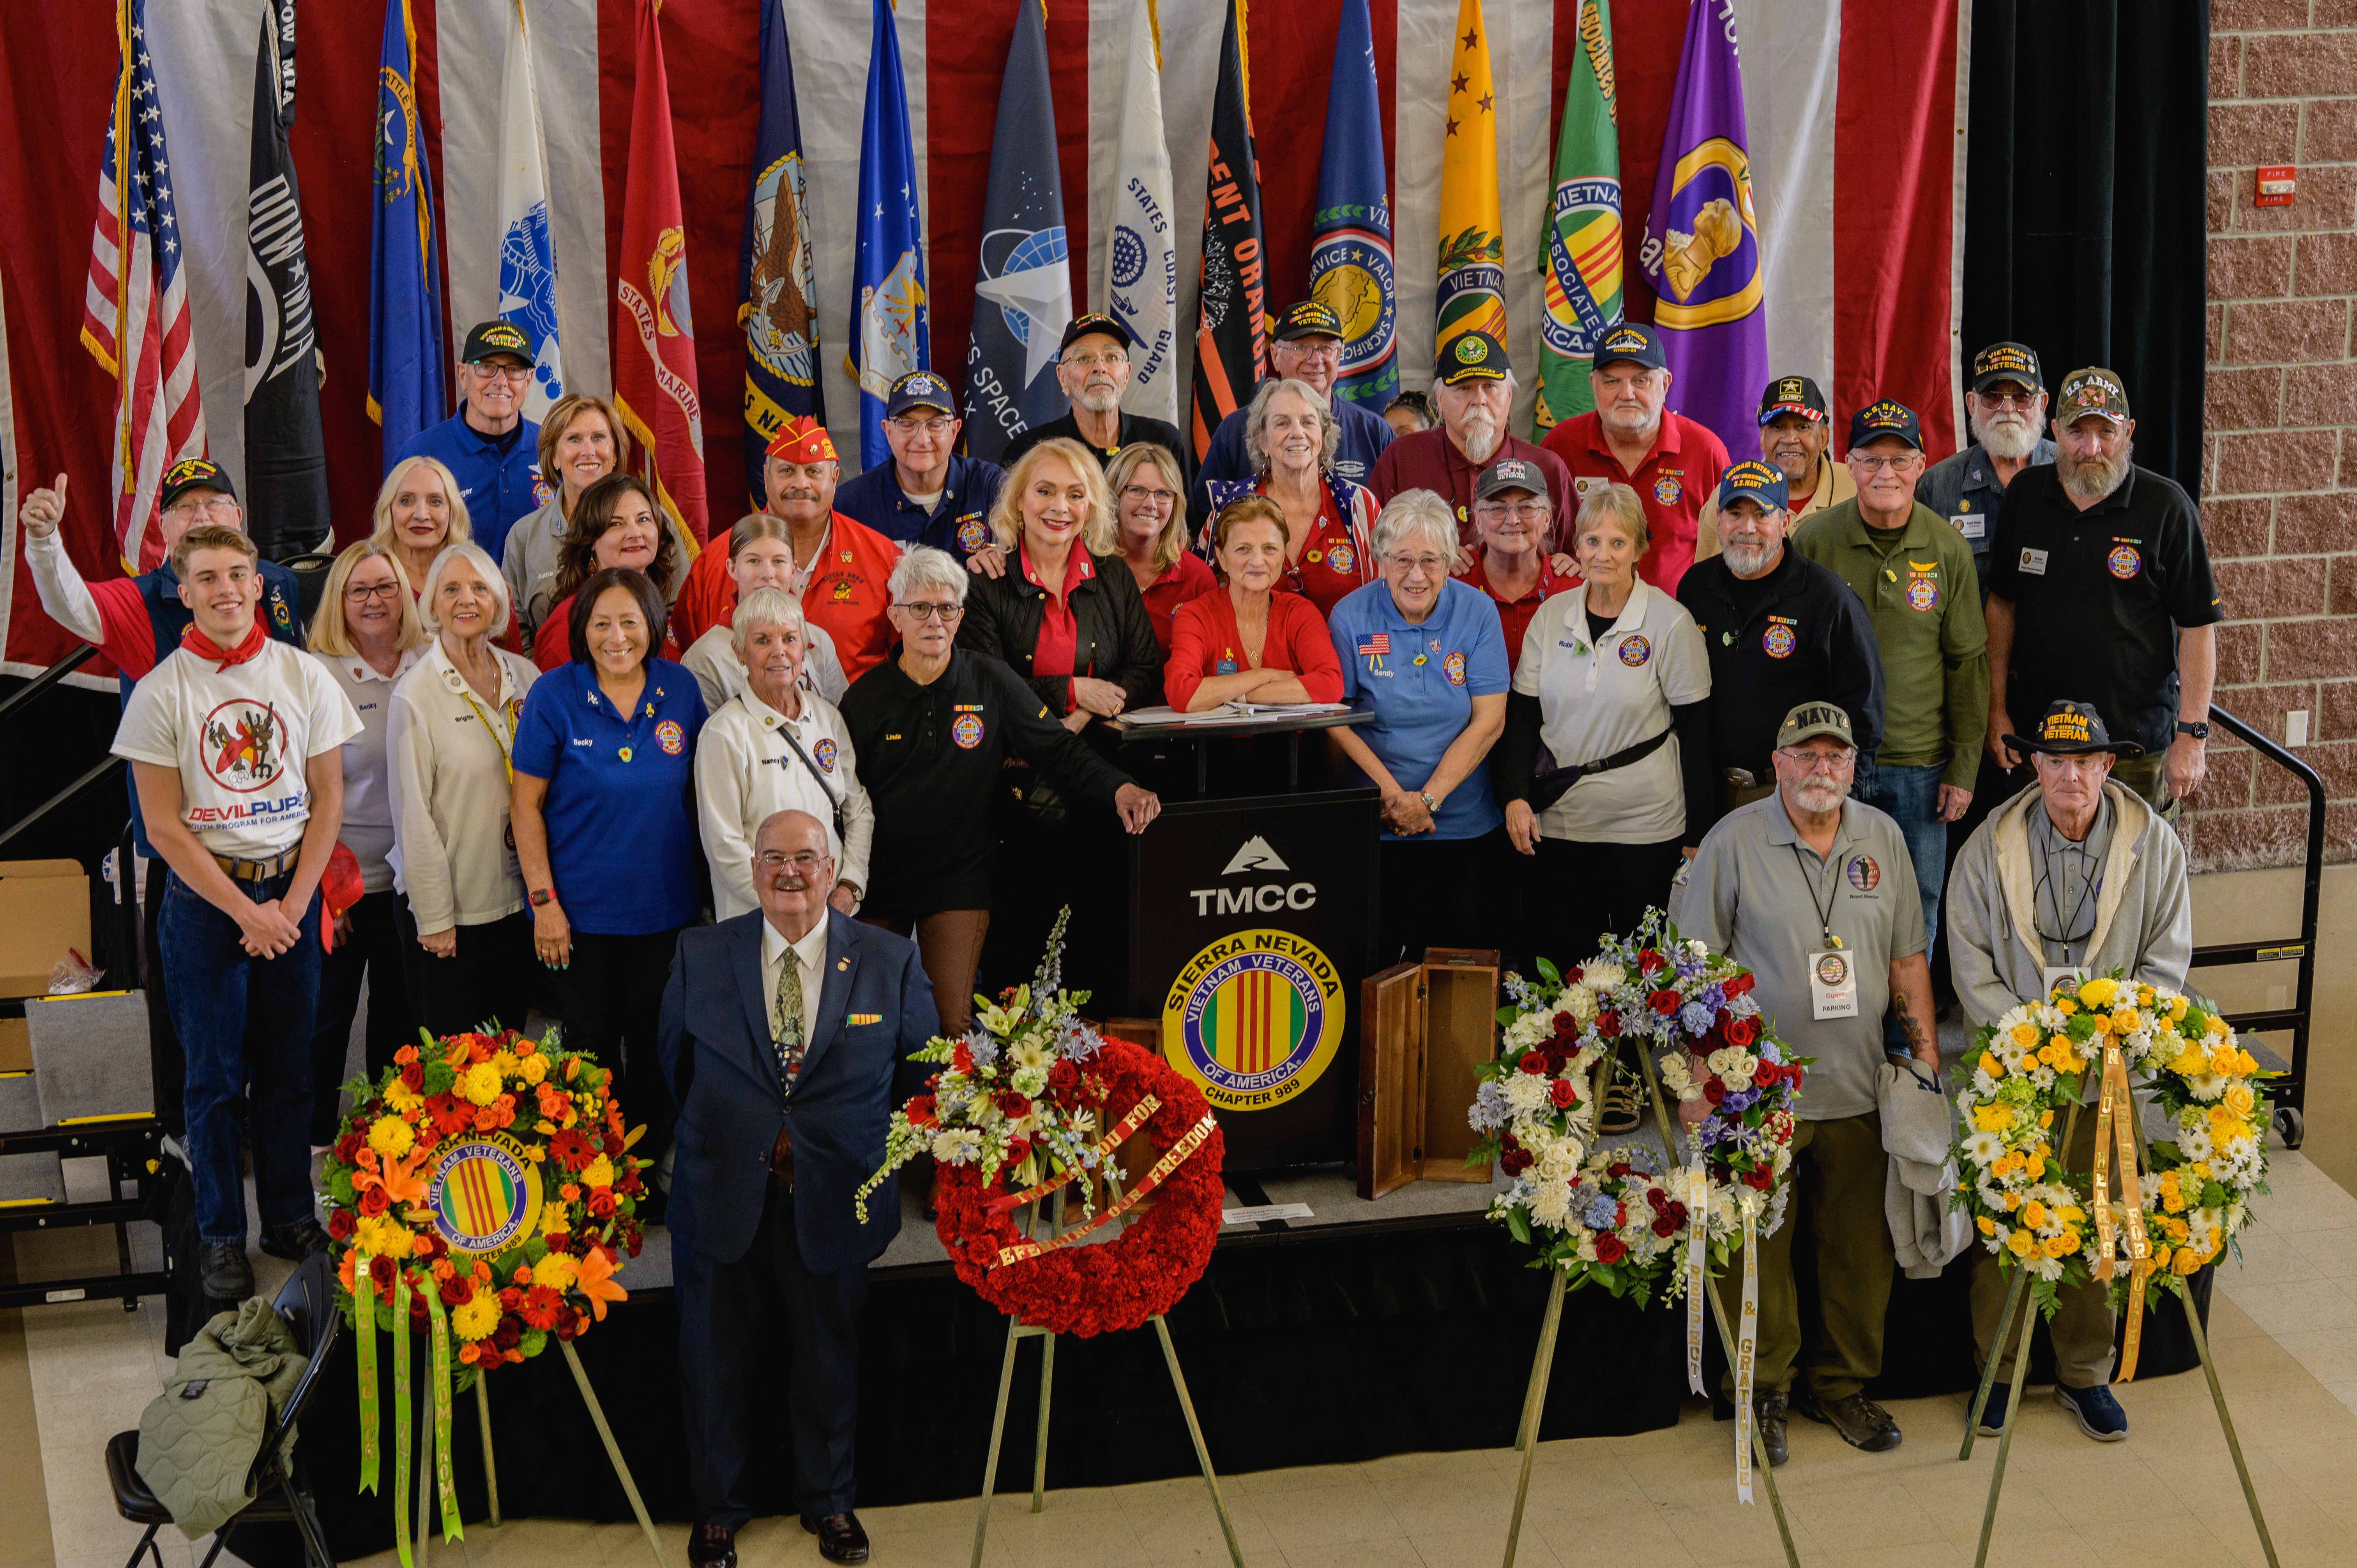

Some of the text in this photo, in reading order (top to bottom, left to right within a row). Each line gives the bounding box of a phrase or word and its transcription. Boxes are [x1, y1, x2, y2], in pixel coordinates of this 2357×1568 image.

[1579, 0, 1615, 101] ssociates
[281, 57, 295, 106] MIA
[385, 72, 410, 105] ATTLE
[1127, 177, 1168, 234] STATES
[1555, 185, 1621, 211] VIETNA
[1367, 253, 1394, 301] VALOR
[1550, 230, 1604, 341] SSOCIATES
[620, 286, 655, 341] STATES
[1233, 237, 1267, 383] ORANGE
[1292, 302, 1331, 316] VIETNAM
[1298, 318, 1329, 326] VETERAN
[480, 326, 526, 346] VIETNAM GULF WAR
[491, 341, 518, 349] VETERAN
[1606, 329, 1648, 344] USCGC SPENCER
[1138, 328, 1172, 385] GUARD
[1988, 348, 2027, 360] VIETNAM
[1989, 362, 2026, 372] VETERAN
[657, 367, 701, 423] MARINE
[903, 373, 926, 383] COAST
[927, 374, 947, 392] GUARD
[2065, 375, 2119, 397] U.S. ARMY
[974, 367, 1028, 440] SPACE
[1863, 403, 1909, 419] U.S. NAVY
[193, 460, 217, 473] DIVISION
[1725, 461, 1777, 484] VIETNAM VETERAN
[2109, 546, 2140, 560] SIERRA NEVADA
[1923, 579, 1936, 592] NEVADA
[1637, 635, 1649, 648] NEVADA
[1765, 625, 1795, 639] SIERRA NEVADA
[1374, 669, 1395, 678] Sandy
[1795, 707, 1843, 730] NAVY
[2047, 713, 2088, 727] VIETNAM
[573, 738, 593, 747] Becky
[2044, 729, 2089, 742] VETERAN
[189, 809, 307, 831] OUTH PROGRAM FOR AMERIC
[1190, 882, 1316, 916] TMCC
[1168, 934, 1340, 1013] SIERRA NEVADA
[1186, 954, 1320, 1023] VIETNAM VETERANS
[1203, 1062, 1226, 1082] OF
[1205, 1078, 1301, 1105] CHAPTER 989
[2099, 1079, 2114, 1131] OUR
[1095, 1128, 1122, 1163] OU
[1123, 1093, 1161, 1132] FOR
[2113, 1087, 2137, 1178] NEVER
[430, 1152, 460, 1206] VIETNAM
[465, 1146, 522, 1185] VETERANS
[998, 1109, 1217, 1267] EFENDING OUR FREEDOM
[2095, 1152, 2113, 1259] HEARTS
[451, 1232, 468, 1246] OF
[465, 1234, 522, 1261] APTER 989
[1689, 1171, 1707, 1378] WITH RESPECT
[395, 1274, 410, 1397] IETNAM
[1738, 1195, 1757, 1487] HONOR & GRATITUDE
[357, 1257, 376, 1462] SALUTING OUR
[433, 1315, 455, 1517] WELCOME HOME
